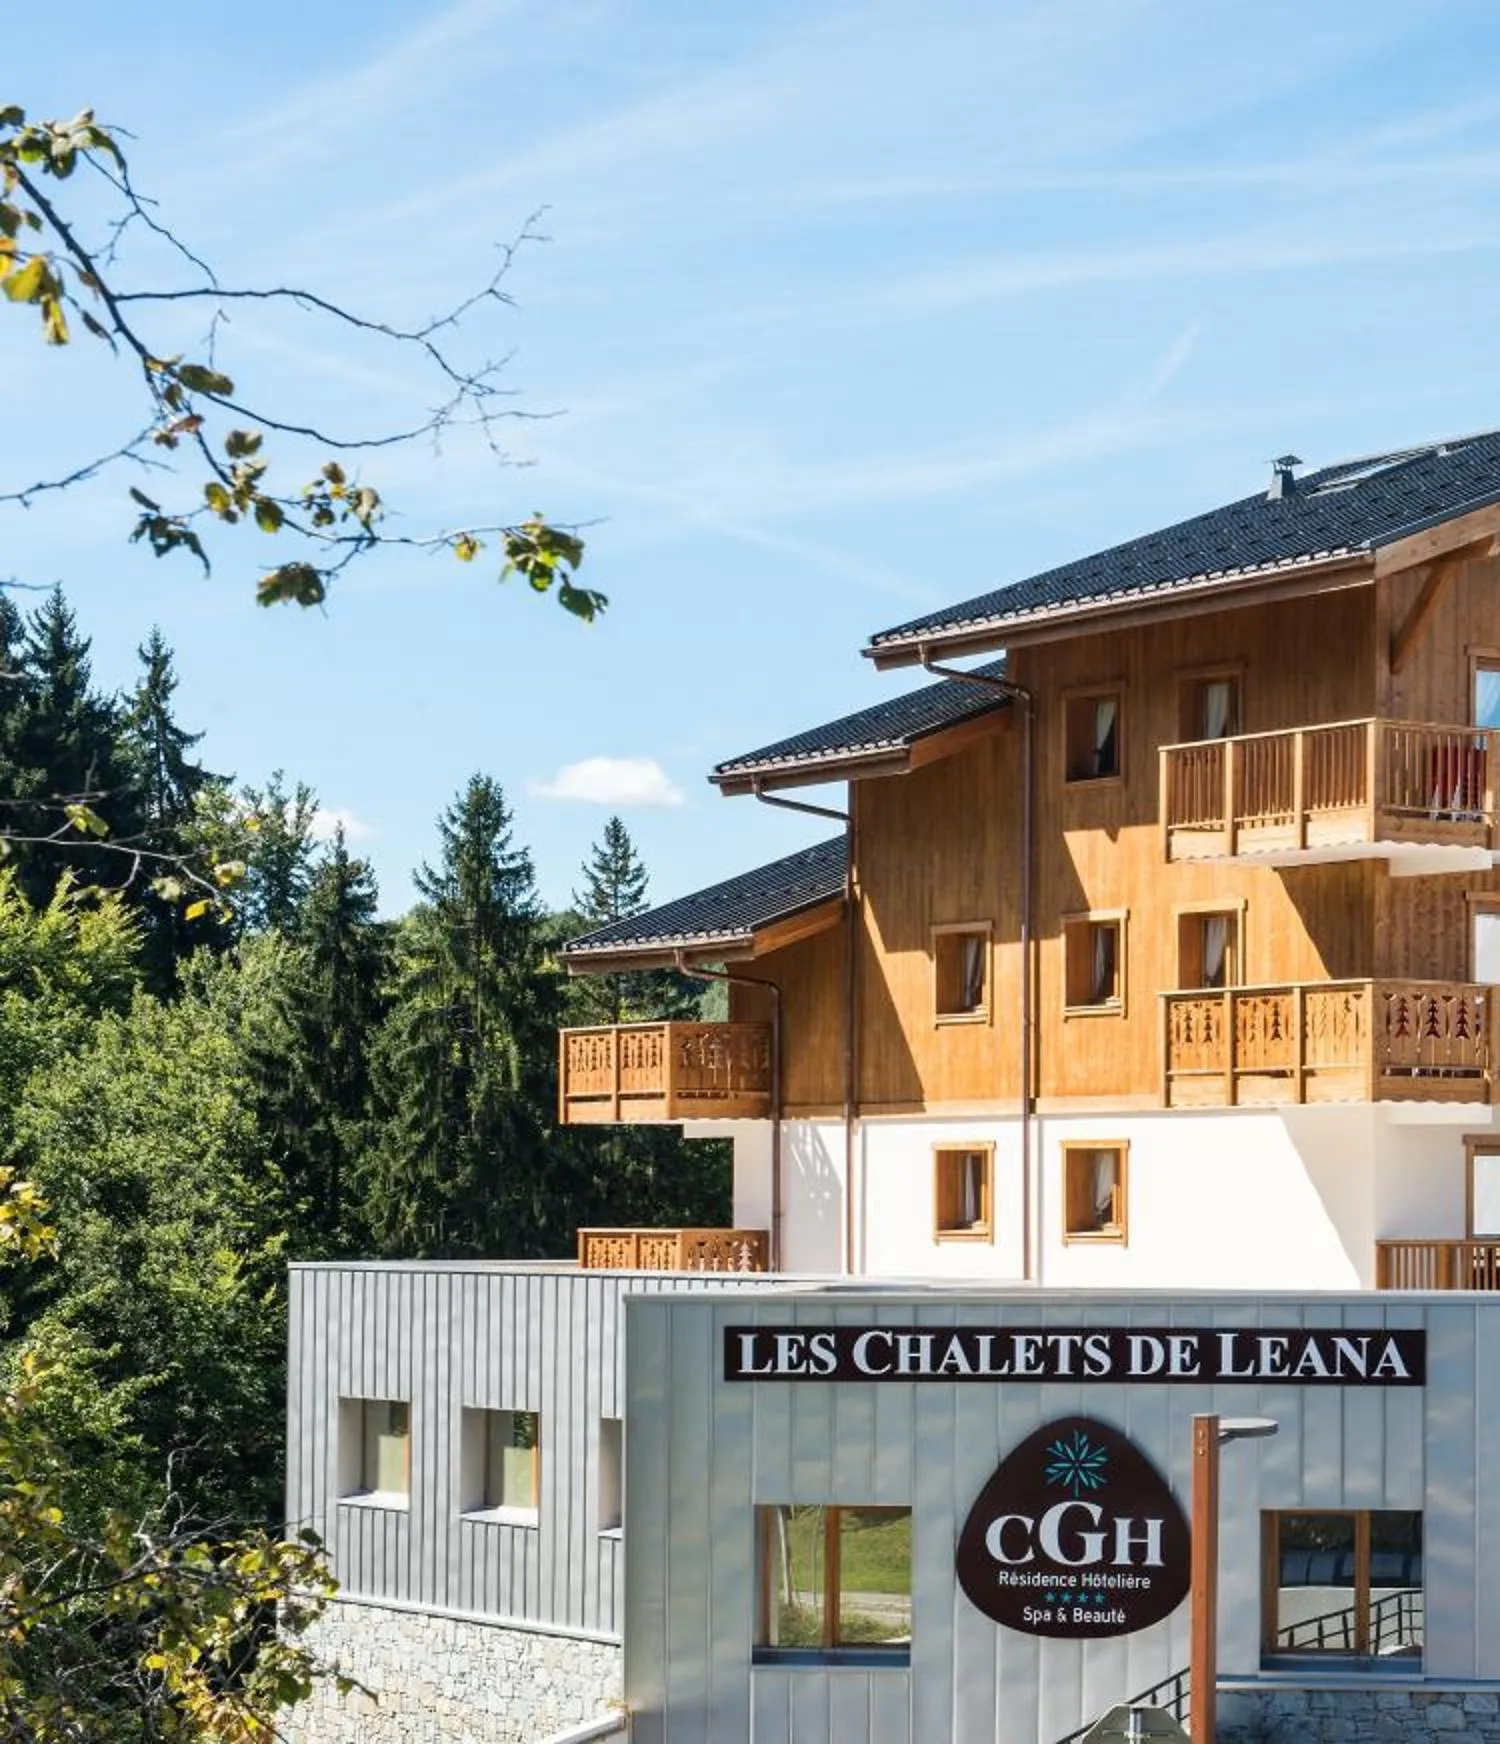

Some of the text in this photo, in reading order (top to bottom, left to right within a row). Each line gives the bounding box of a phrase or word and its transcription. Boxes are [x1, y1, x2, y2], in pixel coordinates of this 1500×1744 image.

[737, 1329, 1411, 1378] LES CHALETS DE LEANA
[985, 1501, 1166, 1567] CGH
[999, 1571, 1151, 1589] Résidence Hôtelière
[1023, 1606, 1127, 1625] Spa & Beauté
